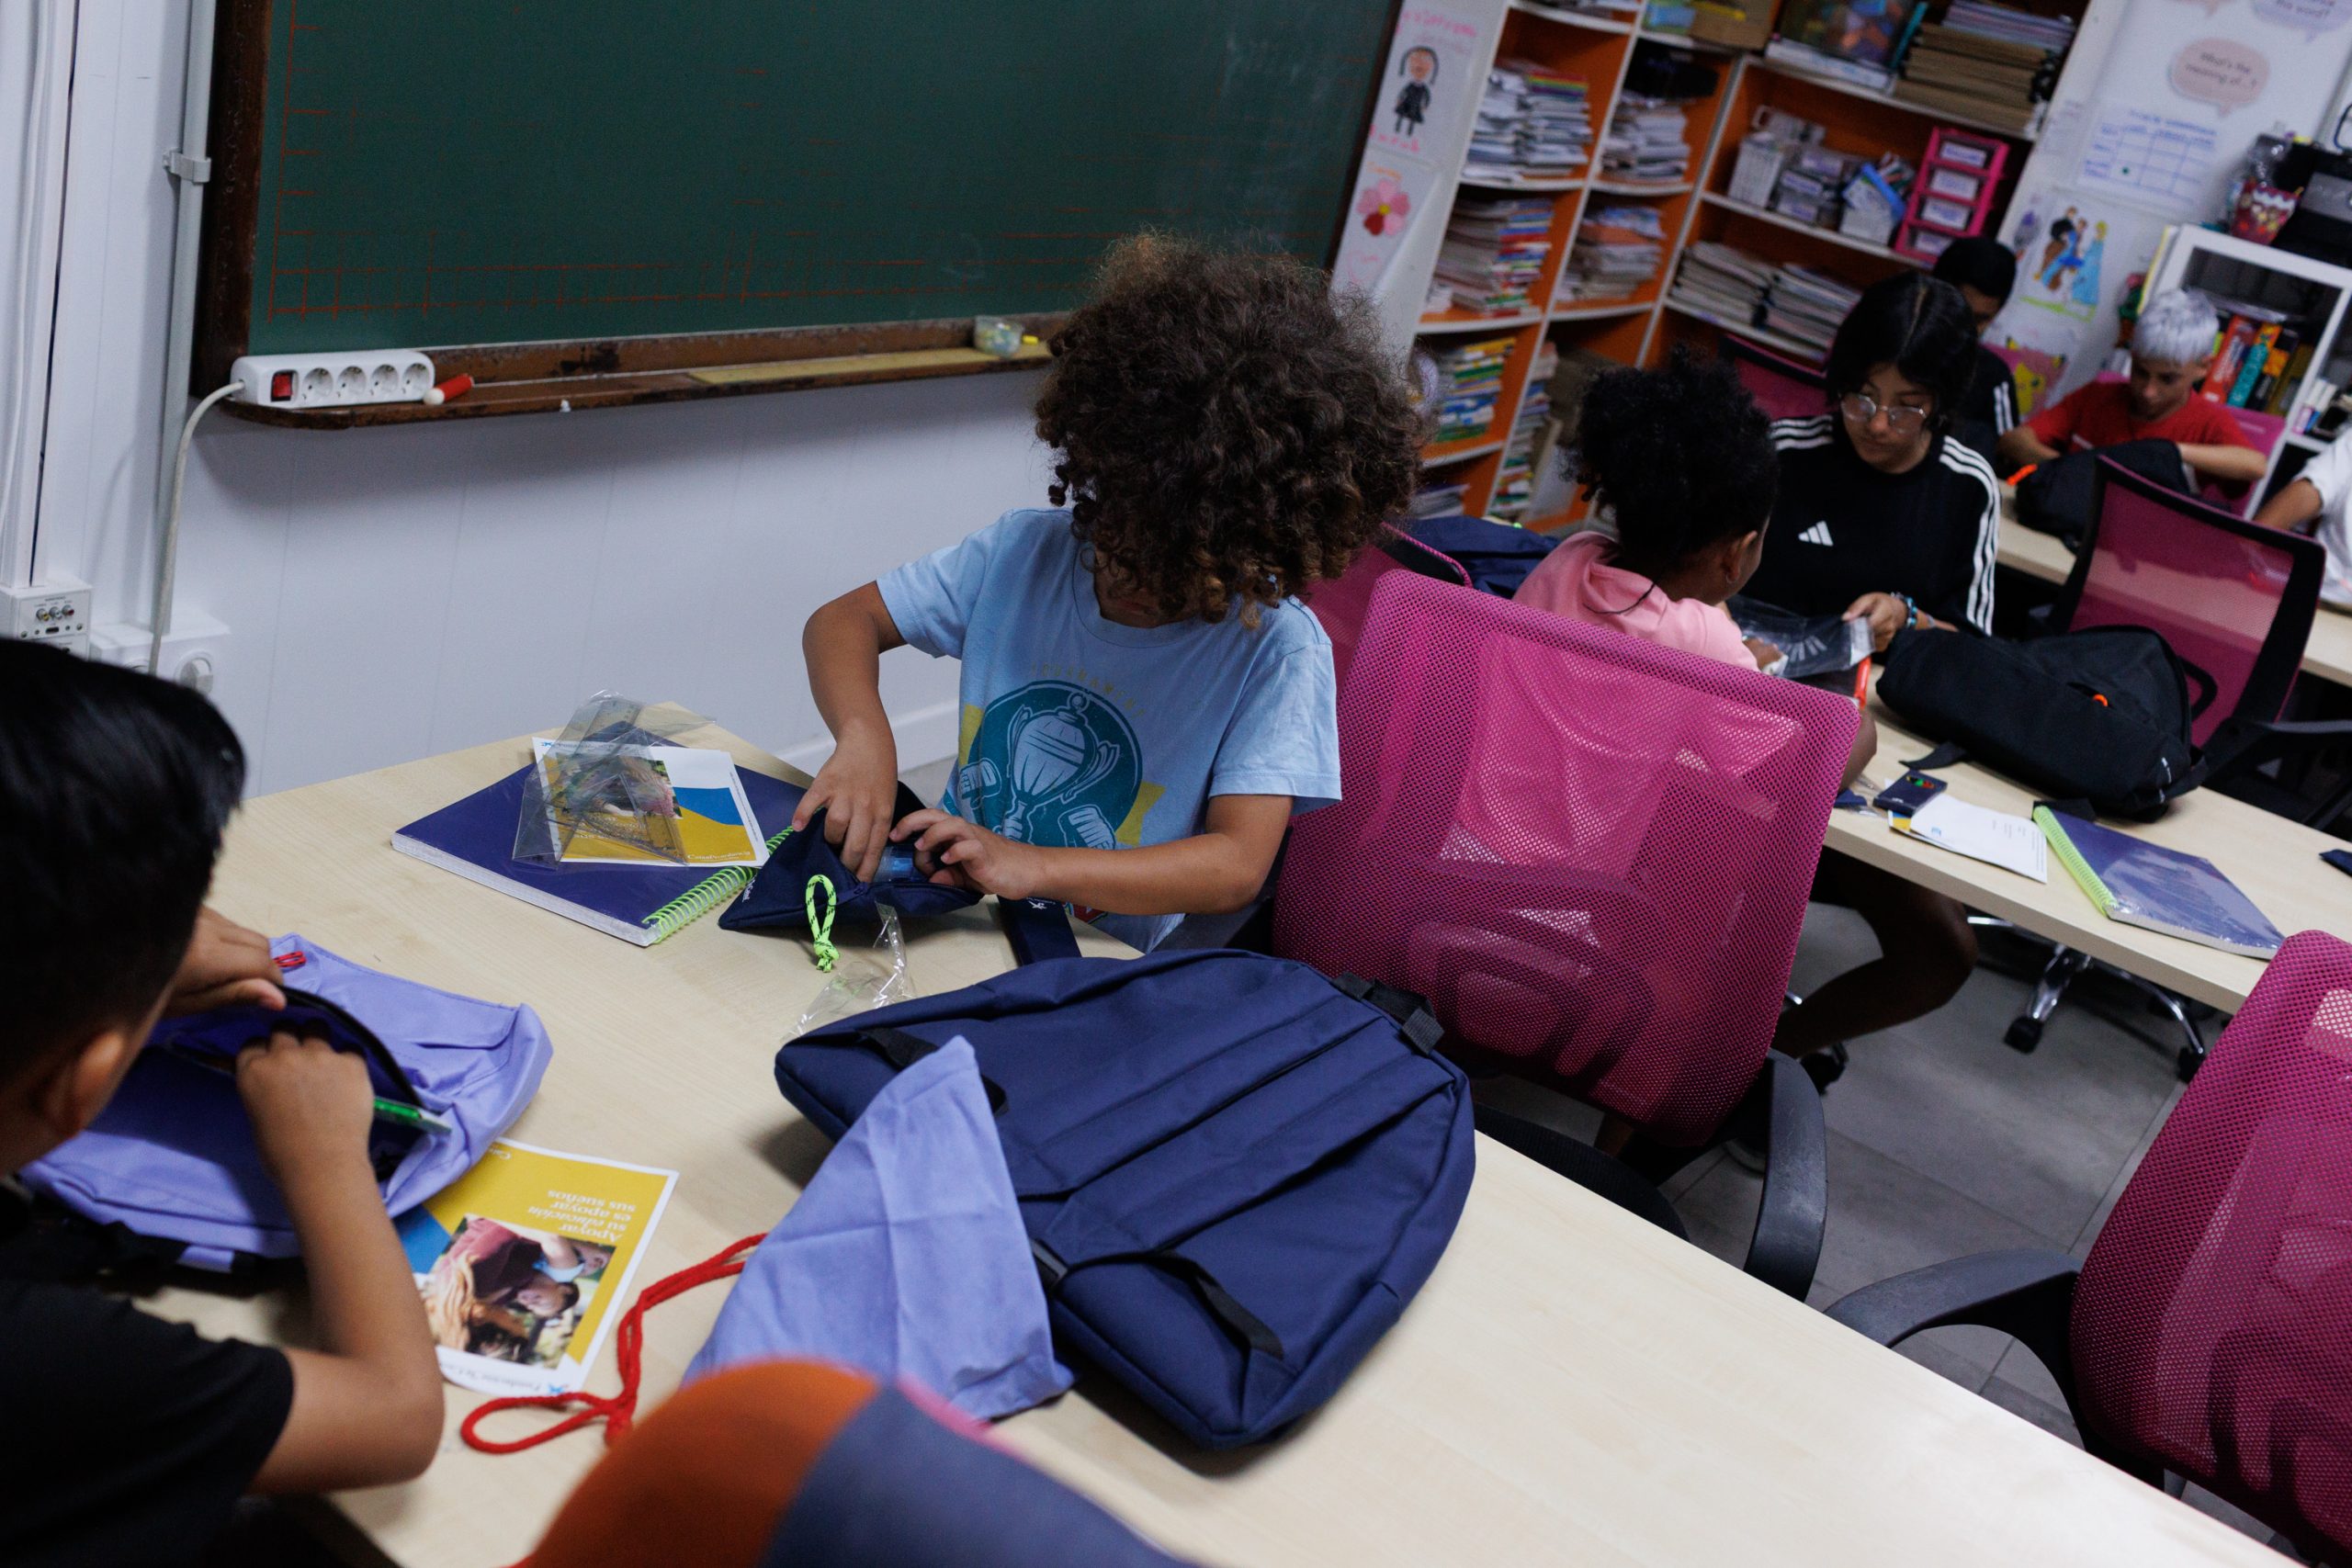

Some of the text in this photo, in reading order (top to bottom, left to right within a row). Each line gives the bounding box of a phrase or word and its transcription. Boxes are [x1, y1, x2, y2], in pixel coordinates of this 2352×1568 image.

[548, 1190, 636, 1213] sus sueños
[551, 1201, 631, 1222] es apoyar
[559, 1223, 622, 1243] Apoyar
[607, 1221, 627, 1232] su
